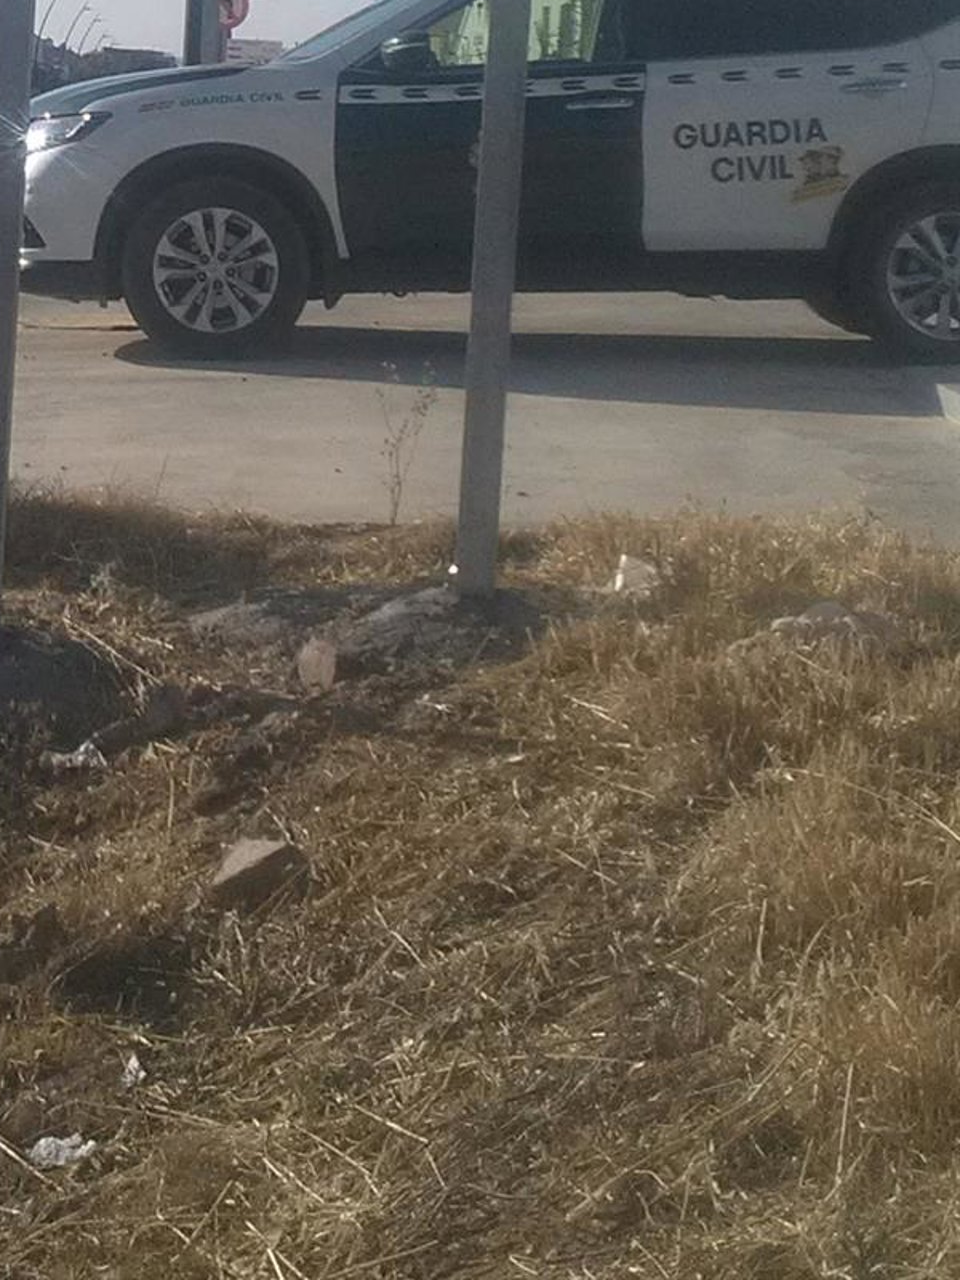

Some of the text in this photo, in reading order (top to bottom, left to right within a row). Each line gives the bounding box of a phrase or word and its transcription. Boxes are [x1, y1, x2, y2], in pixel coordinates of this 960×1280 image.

[180, 93, 244, 108] GUARDIA
[672, 118, 829, 150] GUARDIA
[710, 154, 795, 184] CIVIL
